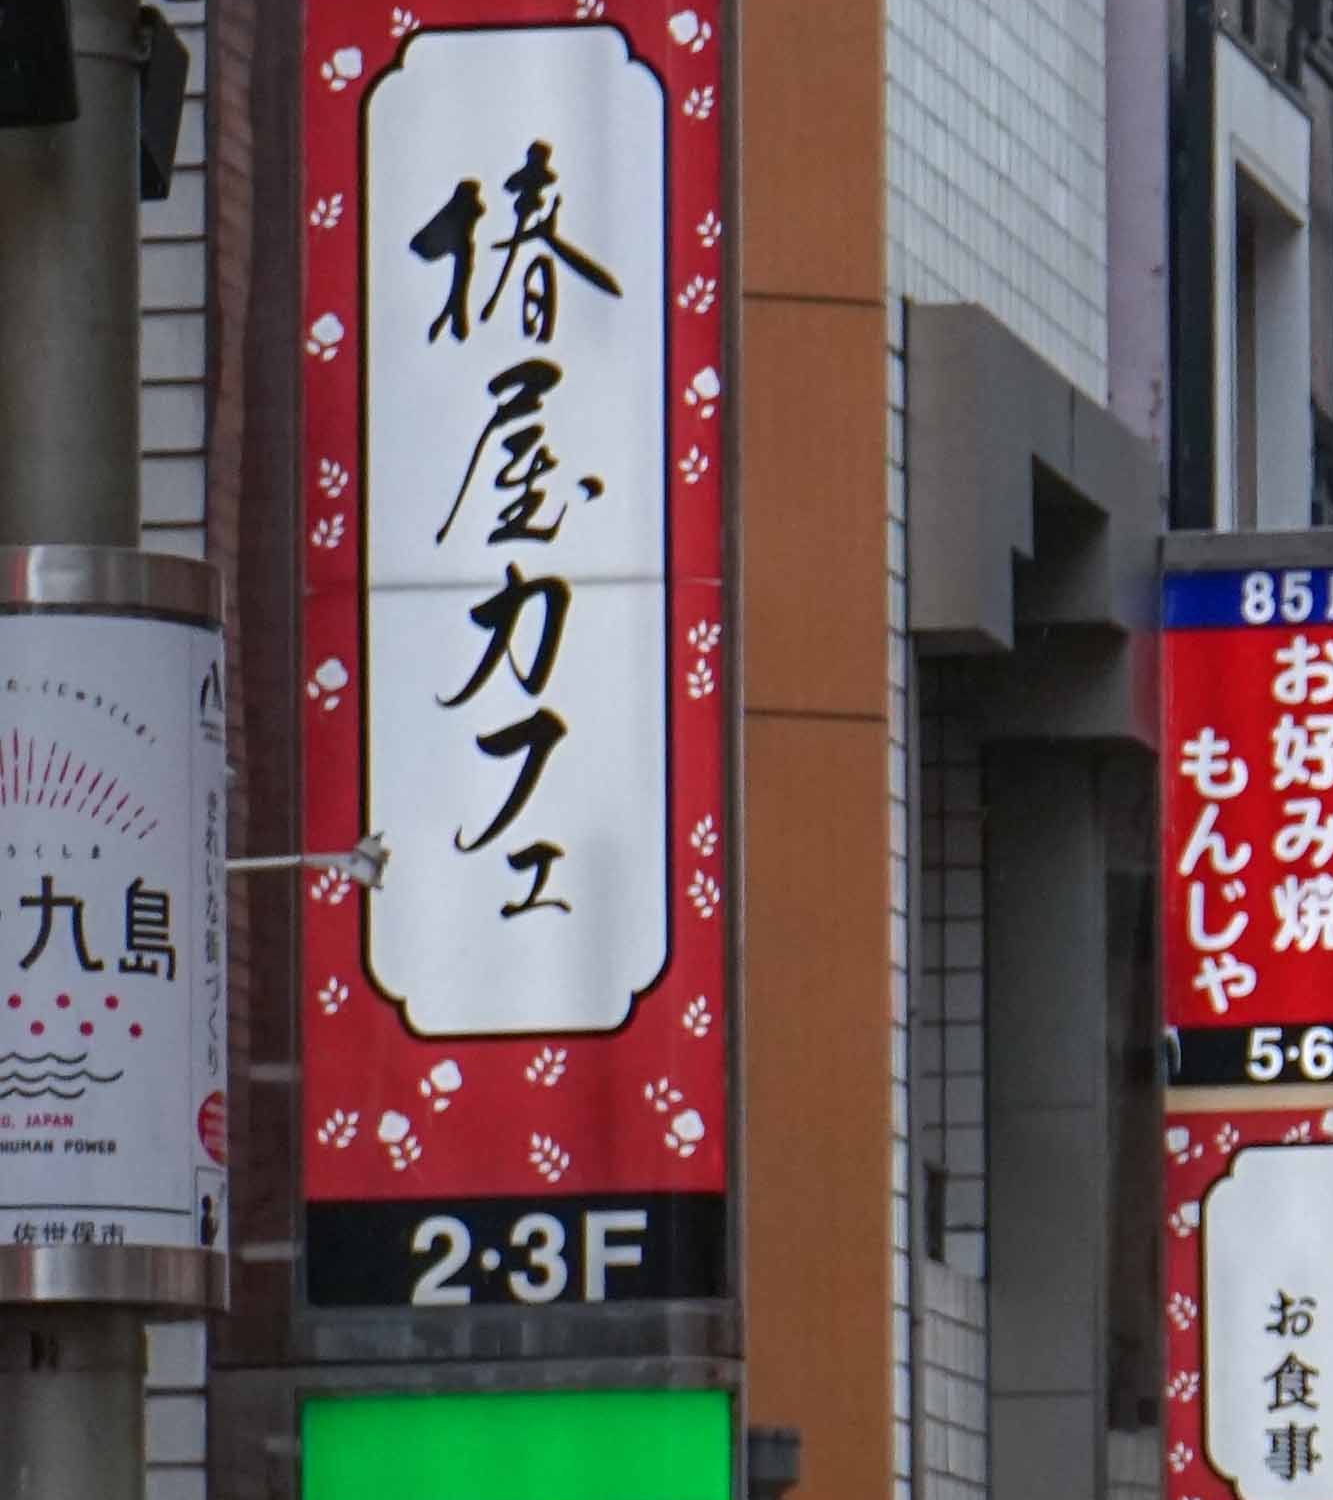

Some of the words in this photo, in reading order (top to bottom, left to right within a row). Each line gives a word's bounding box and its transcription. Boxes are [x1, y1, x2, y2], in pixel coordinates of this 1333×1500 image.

[408, 140, 622, 920] 椿屋カフェ
[1178, 728, 1260, 1015] もんじゃ
[1262, 1288, 1325, 1485] お食事
